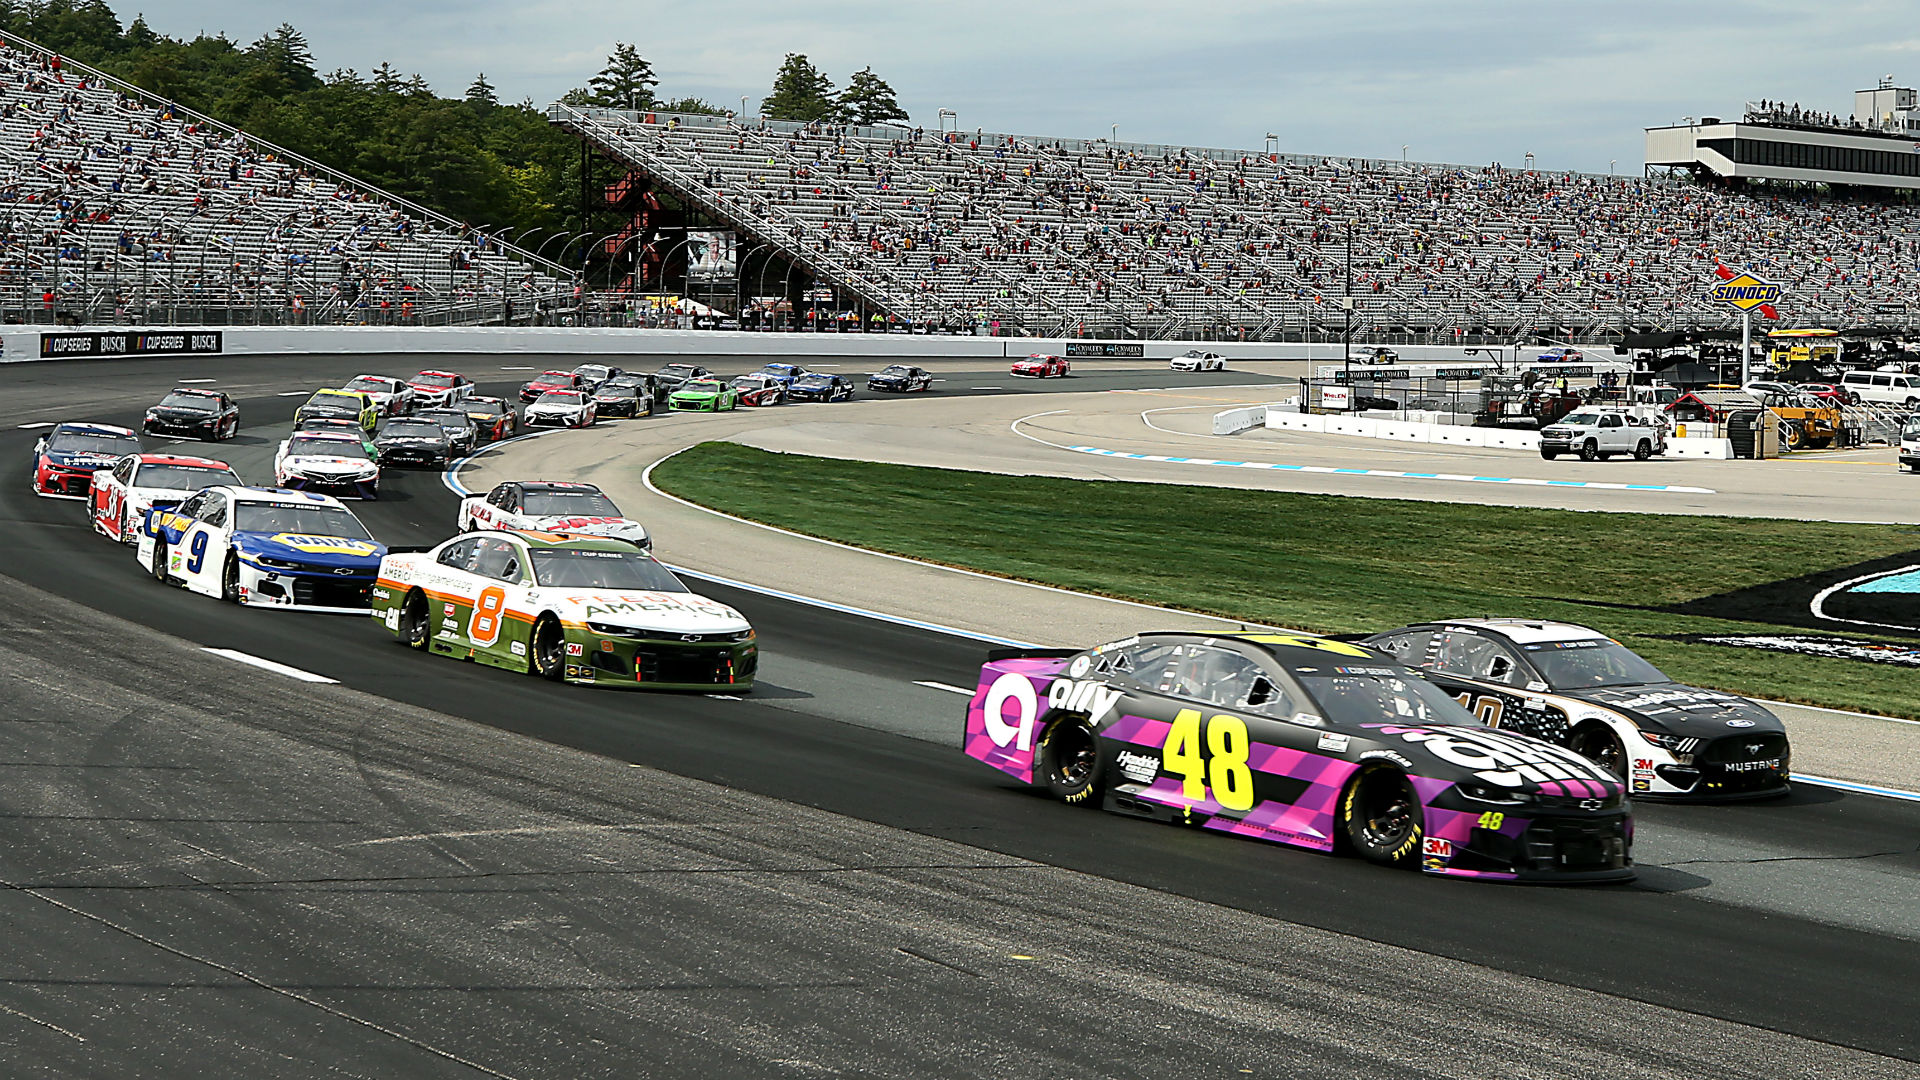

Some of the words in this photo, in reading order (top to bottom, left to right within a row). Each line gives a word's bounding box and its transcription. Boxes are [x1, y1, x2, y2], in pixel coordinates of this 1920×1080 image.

[1714, 286, 1778, 299] SUNOCO
[53, 338, 68, 352] CUP
[67, 337, 92, 352] SERIES
[101, 336, 126, 352] BUSCH
[146, 336, 161, 350] CUP
[160, 336, 184, 350] SERIES
[191, 335, 216, 351] BUSCH
[1114, 344, 1142, 352] FOXWOODS
[1050, 364, 1058, 374] 15
[105, 485, 119, 521] 38
[286, 535, 365, 549] NAPA
[187, 530, 209, 575] 9
[266, 571, 280, 581] 9
[469, 585, 506, 643] 8
[586, 602, 747, 621] AMERICA
[567, 644, 583, 655] 3M
[601, 640, 614, 652] 8
[1048, 678, 1126, 727] ally
[1116, 750, 1160, 771] Hendrick
[1162, 708, 1255, 812] 48
[1633, 758, 1653, 770] 3M
[1725, 758, 1780, 772] MUSTANG
[1065, 782, 1094, 803] EAGLE
[1477, 811, 1505, 831] 48
[1391, 822, 1422, 861] EAGLE
[1425, 839, 1451, 856] 3M
